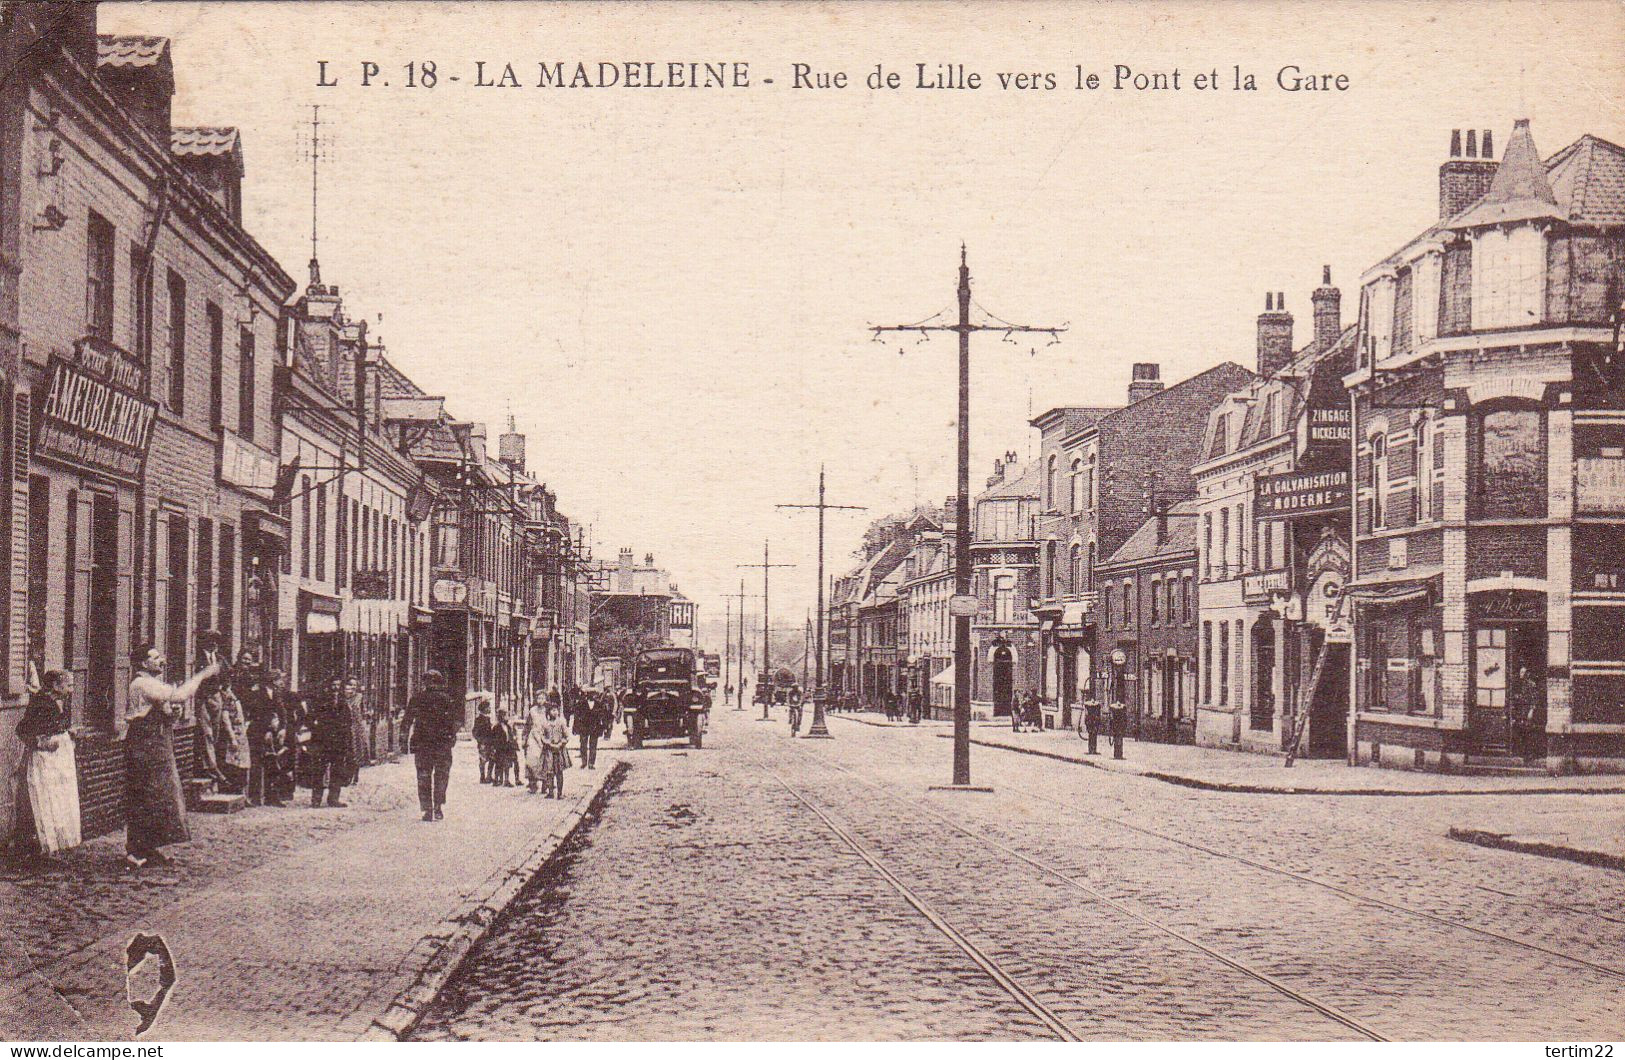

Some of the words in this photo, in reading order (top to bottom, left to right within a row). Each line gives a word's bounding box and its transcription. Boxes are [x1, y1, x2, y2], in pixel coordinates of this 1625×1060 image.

[43, 365, 155, 449] AMEUBLEMENT
[1312, 409, 1350, 423] ZINGAGE
[1312, 427, 1351, 440] NICKELAGE
[1260, 483, 1271, 496] LA
[1274, 471, 1347, 494] GALVANISATION
[1274, 491, 1332, 510] MODERNE
